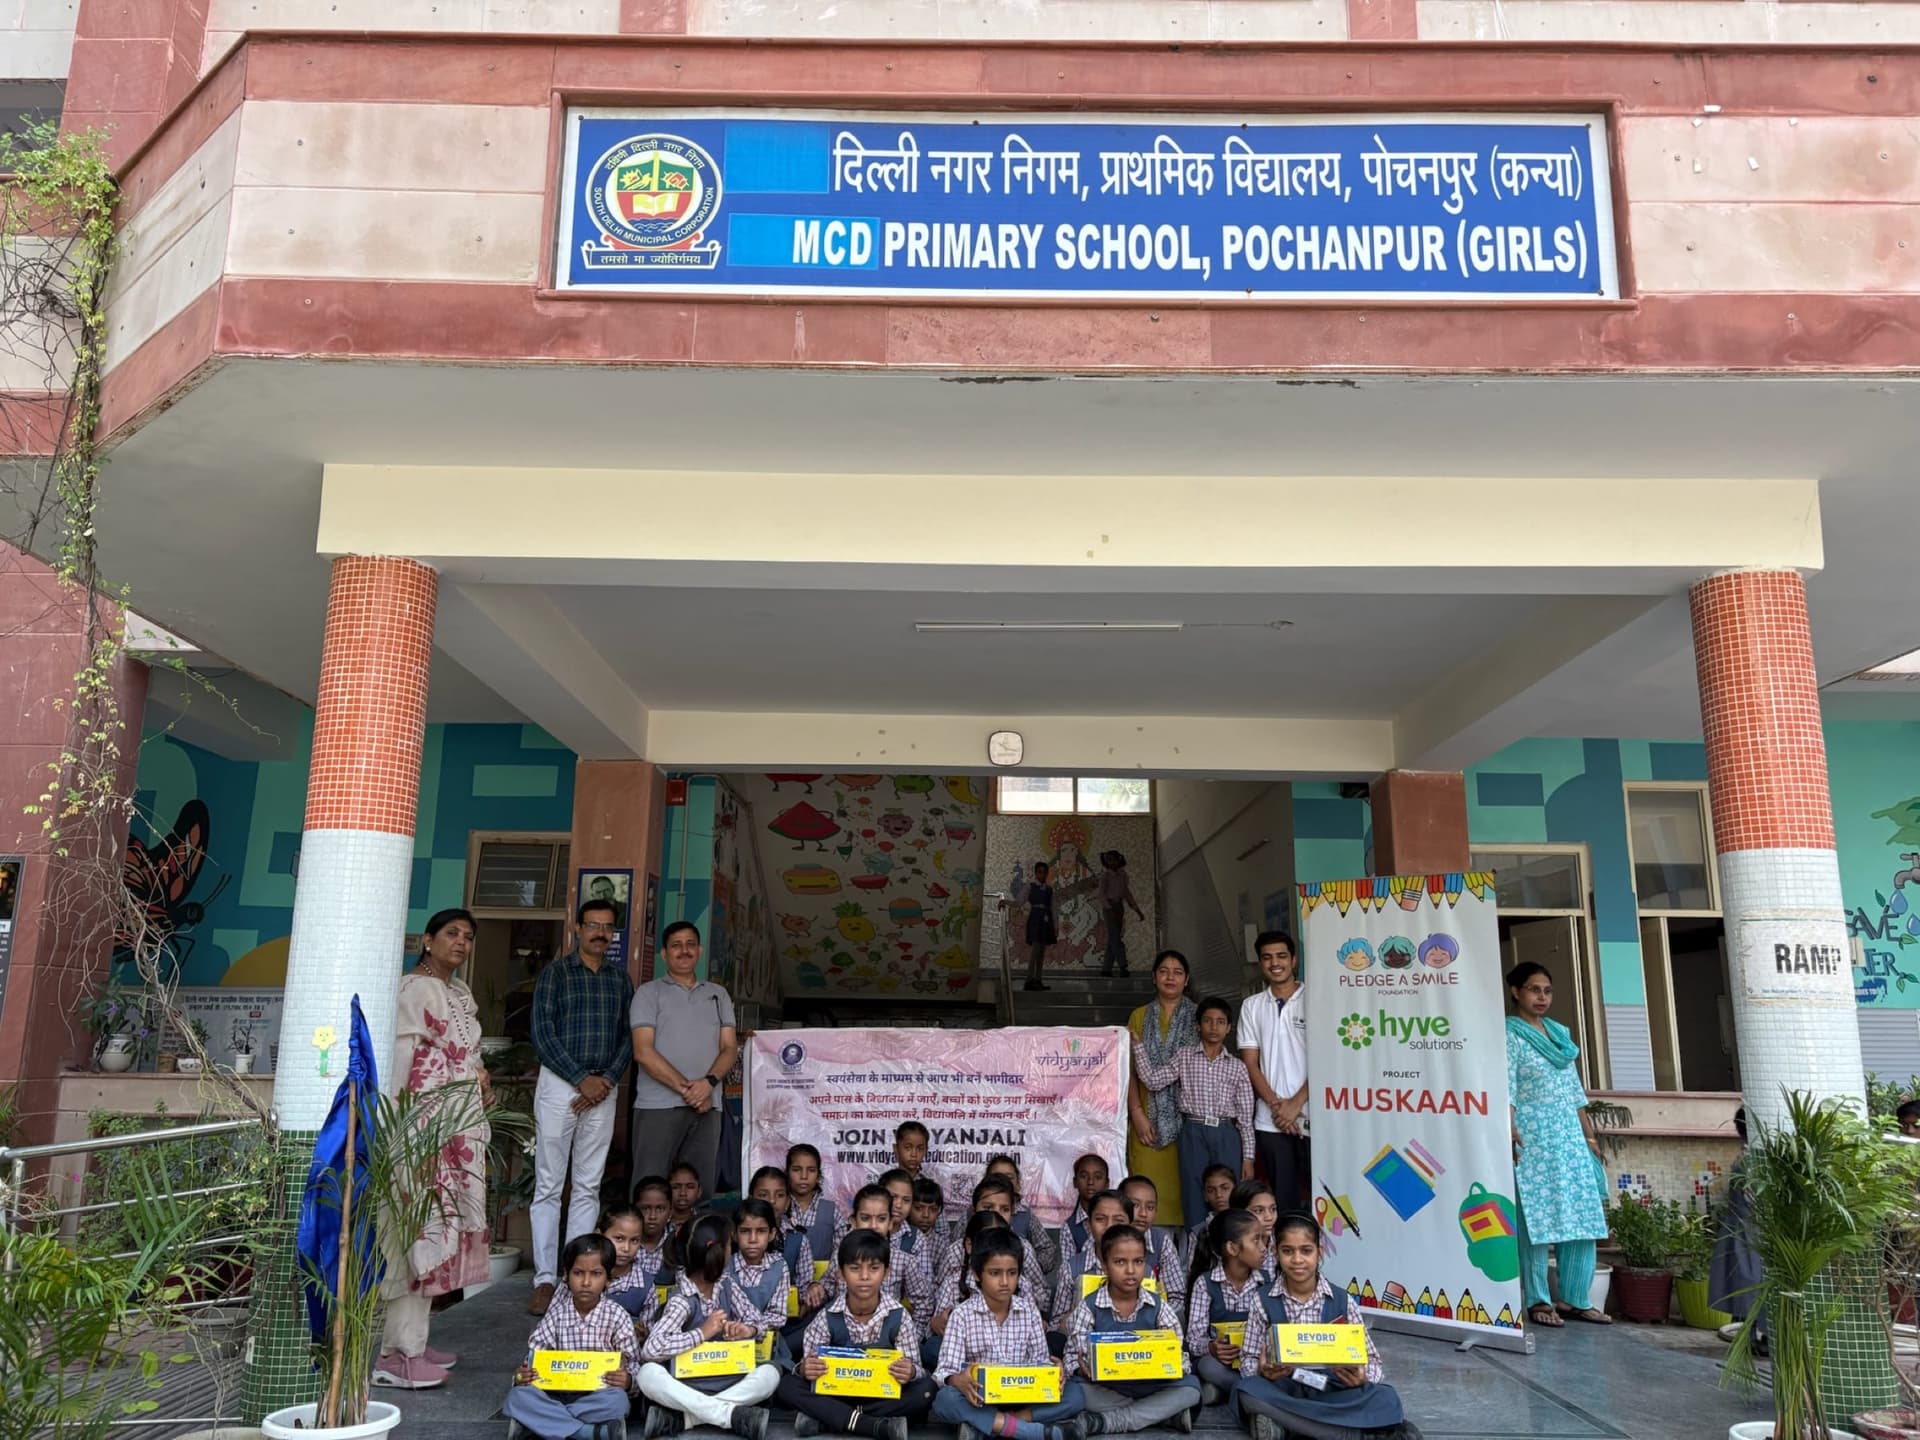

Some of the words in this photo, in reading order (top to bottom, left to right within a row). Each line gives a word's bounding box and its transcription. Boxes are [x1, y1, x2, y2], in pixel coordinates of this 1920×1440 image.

[630, 139, 658, 153] दिल्ली
[663, 142, 684, 154] नगर
[686, 150, 705, 169] निगम
[833, 131, 920, 193] दिल्ली
[928, 151, 993, 194] नगर
[1001, 134, 1090, 202] निगम,
[1099, 134, 1215, 196] प्राथमिक
[1222, 135, 1351, 203] विद्यालय,
[1360, 133, 1478, 215] पोचनपुर
[1490, 144, 1583, 201] (कन्या)
[594, 187, 605, 216] SOUTH
[603, 215, 623, 235] DELHI
[623, 232, 674, 244] MUNICIPAL
[674, 187, 714, 238] CORPORATION
[600, 253, 628, 264] तमसो
[634, 255, 645, 264] मा
[792, 219, 872, 266] MCD
[884, 222, 1044, 269] PRIMARY
[1054, 223, 1211, 282] SCHOOL,
[1222, 225, 1447, 271] POCHANPUR
[1457, 219, 1587, 279] (GIRLS)
[1861, 948, 1901, 976] TER
[1339, 973, 1395, 987] PLEDGE
[1398, 974, 1408, 985] A
[1412, 972, 1459, 985] SMILE
[1379, 1008, 1450, 1044] hyve
[1037, 1051, 1107, 1072] vidyanjali
[1382, 1071, 1420, 1079] PROJECT
[868, 1071, 879, 1083] के
[927, 1074, 948, 1084] आप
[1324, 1086, 1489, 1116] MUSKAAN
[833, 1128, 886, 1145] JOIN
[893, 1128, 1026, 1147] YANJALI
